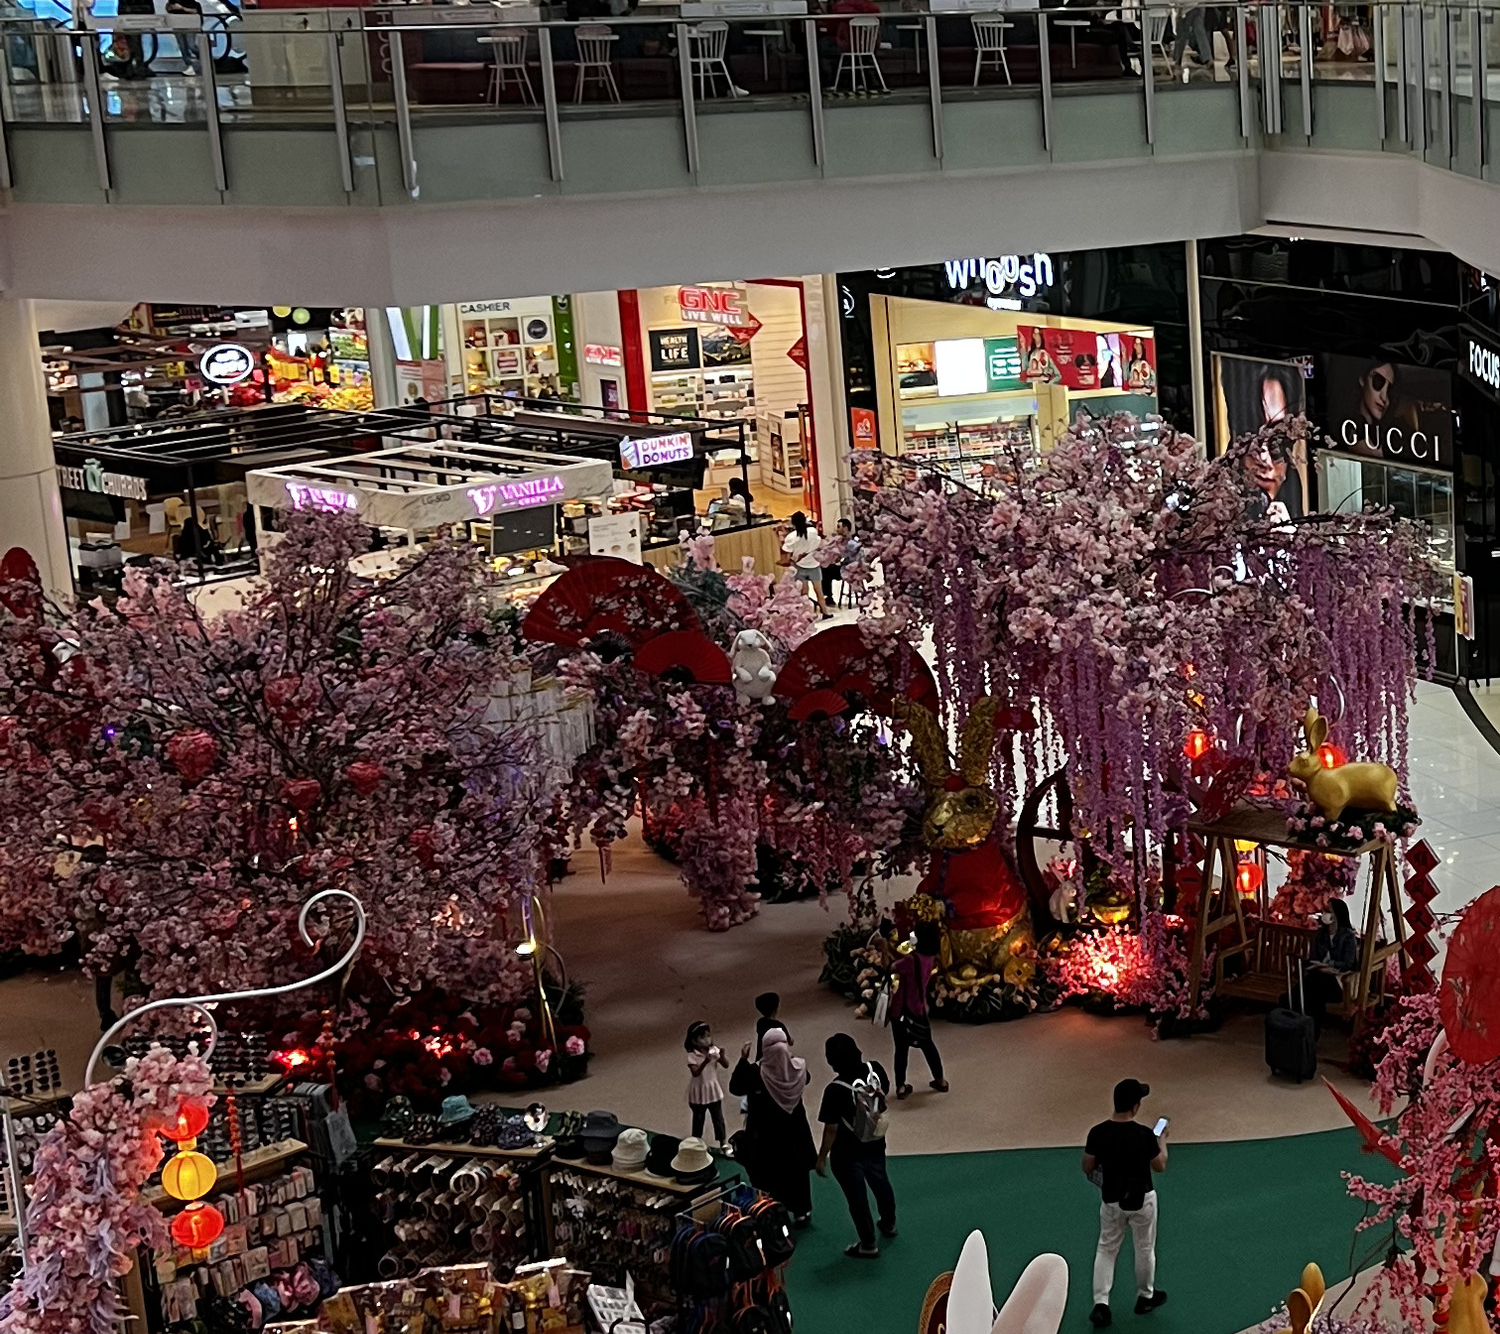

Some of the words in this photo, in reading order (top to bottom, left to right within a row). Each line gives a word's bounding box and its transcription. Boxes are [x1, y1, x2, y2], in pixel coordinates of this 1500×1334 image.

[460, 301, 510, 314] CASHIER
[680, 288, 742, 315] GNC
[681, 310, 707, 322] LIVE
[711, 313, 743, 325] WELL
[660, 347, 689, 360] LIFE
[1468, 340, 1500, 390] FOCUS
[1341, 419, 1441, 462] GUCCI
[642, 447, 690, 465] DONUTS
[500, 475, 565, 501] VANILLA
